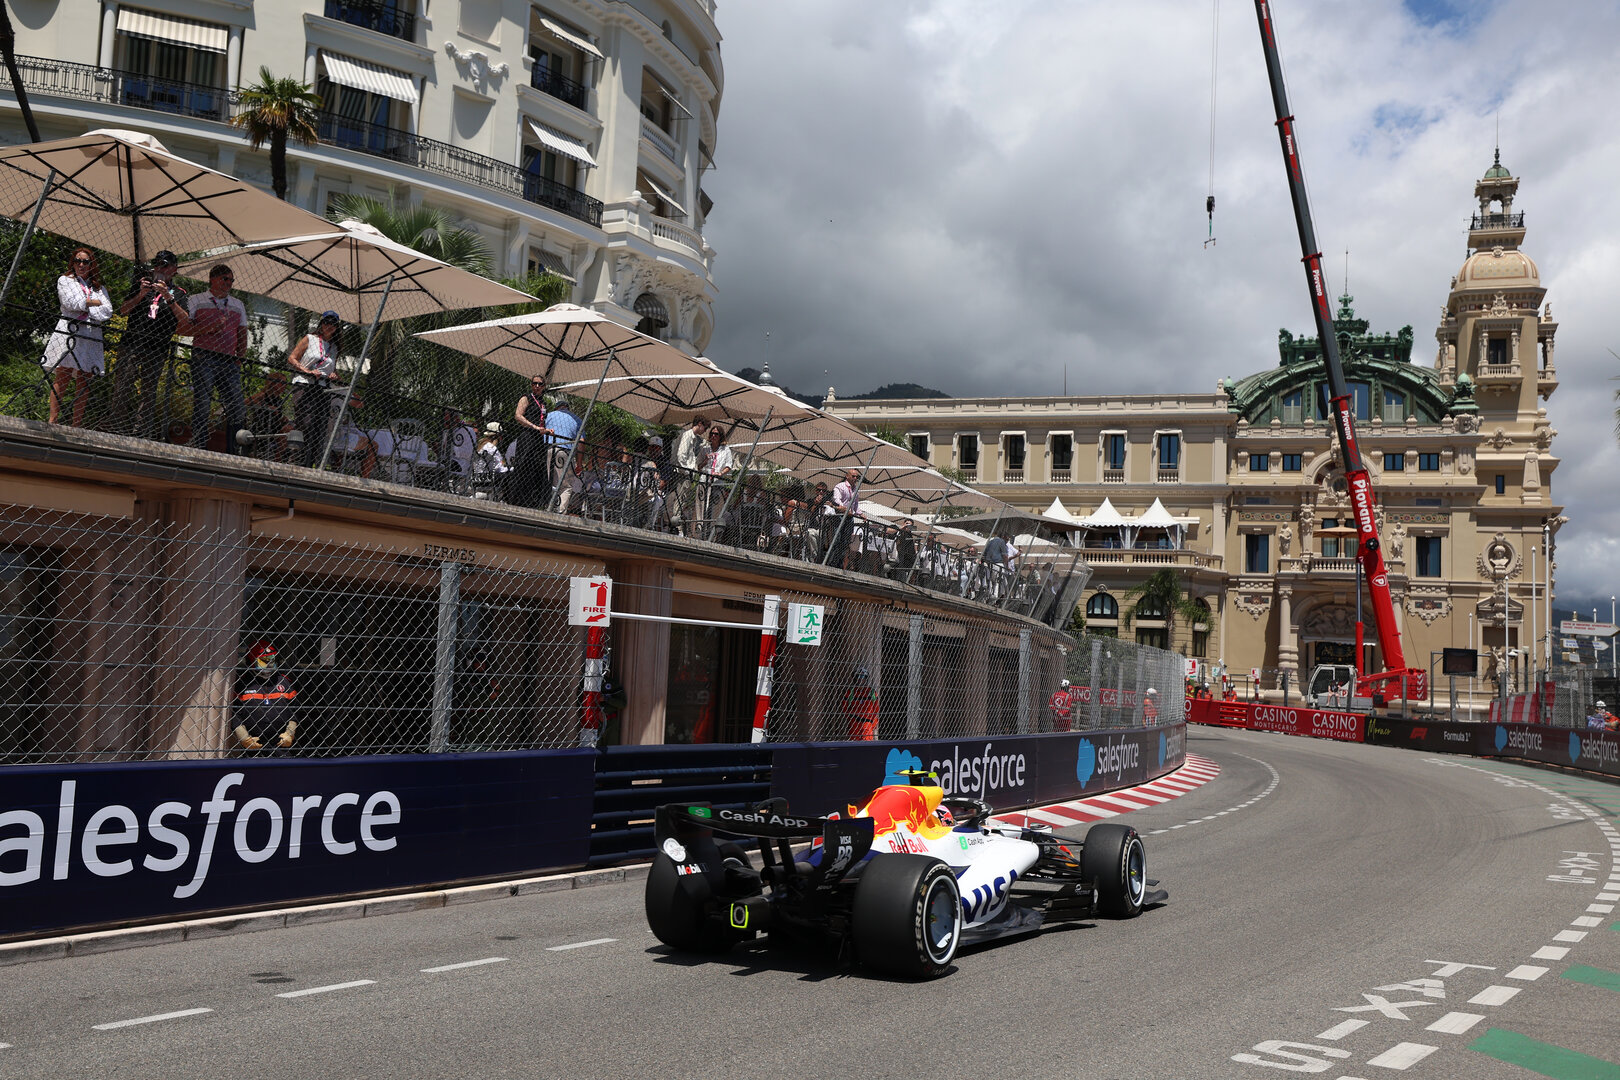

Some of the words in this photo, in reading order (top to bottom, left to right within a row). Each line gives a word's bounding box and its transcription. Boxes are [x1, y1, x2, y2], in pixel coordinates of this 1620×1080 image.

[1340, 409, 1353, 440] Piovano
[1353, 479, 1373, 533] Piovano
[743, 591, 766, 604] HERM
[582, 606, 606, 614] FIRE
[1068, 687, 1092, 702] SINO
[1102, 691, 1137, 706] CAINO
[1254, 706, 1298, 725] CASINO
[1312, 712, 1357, 732] CASINO
[1443, 730, 1465, 742] Formula
[1508, 725, 1543, 756] salesforce
[1097, 734, 1140, 780] salesforce
[1581, 732, 1618, 768] salesforce
[930, 743, 1026, 801] salesforce
[719, 809, 765, 824] Cash
[769, 815, 809, 828] App
[888, 840, 910, 854] Red
[908, 836, 929, 853] Bull
[676, 863, 702, 876] Mobil
[960, 869, 1018, 925] VISA
[914, 900, 923, 951] ZERO
[1230, 959, 1497, 1073] TAXIS
